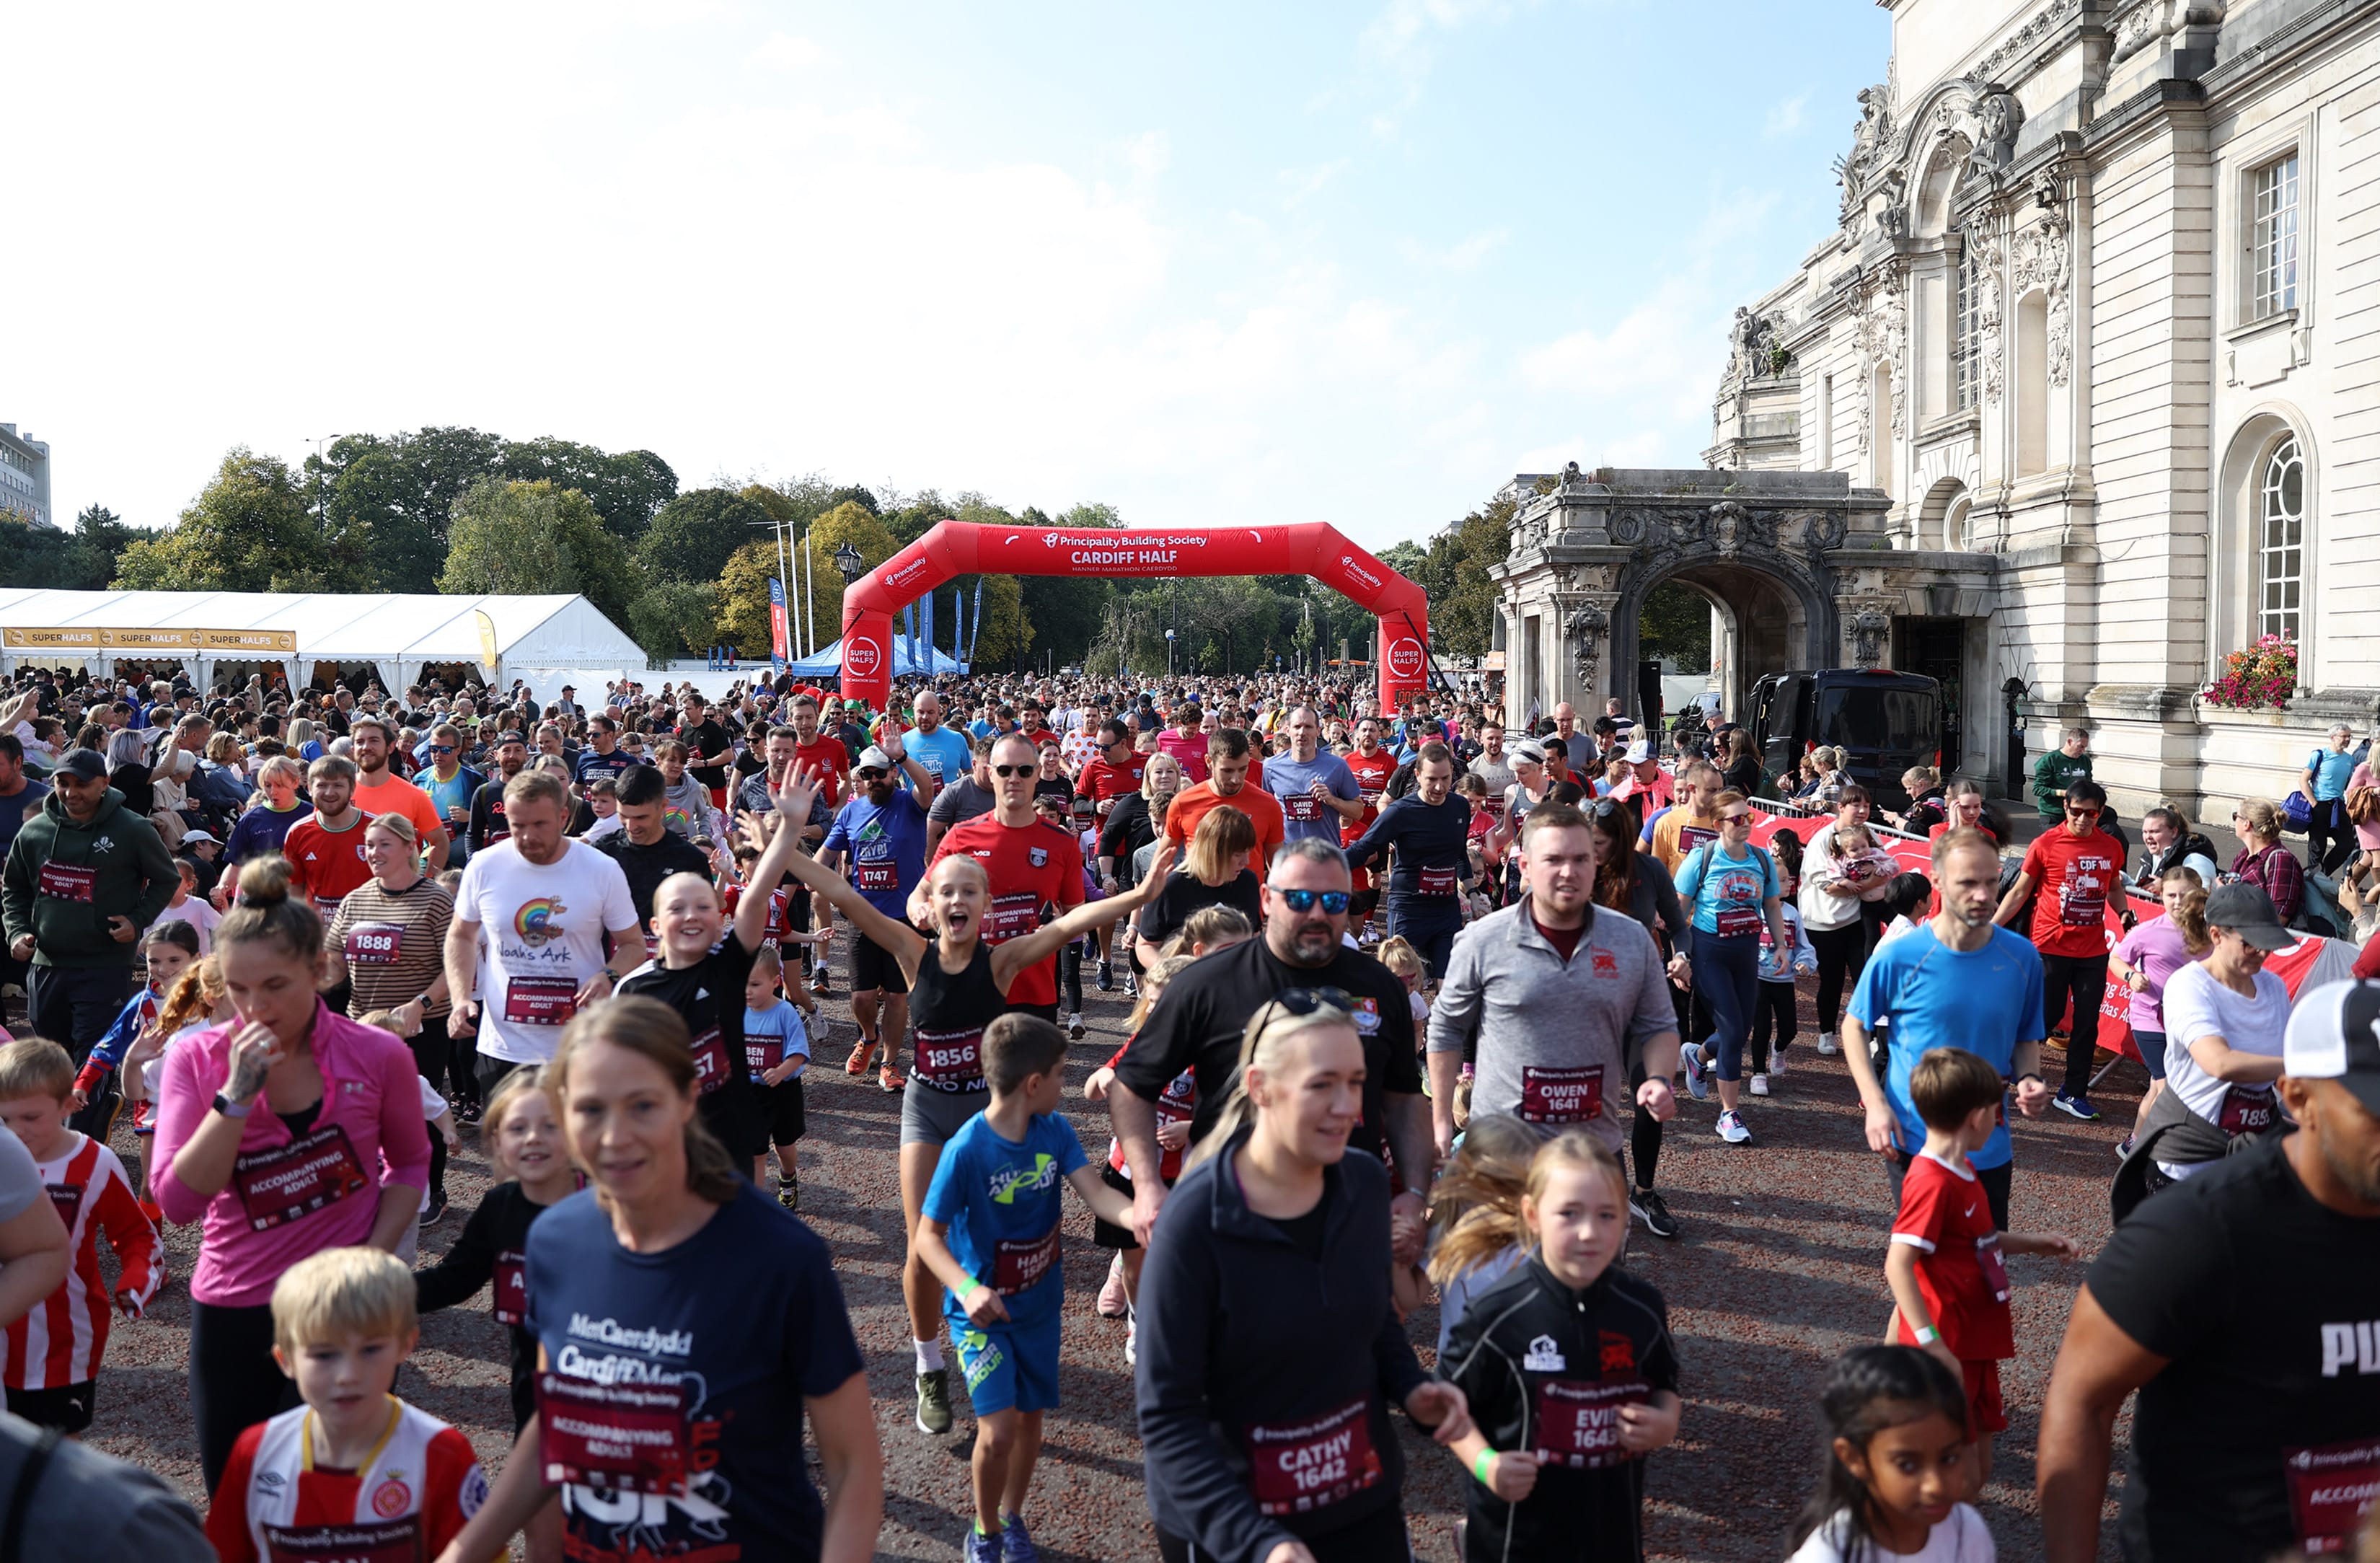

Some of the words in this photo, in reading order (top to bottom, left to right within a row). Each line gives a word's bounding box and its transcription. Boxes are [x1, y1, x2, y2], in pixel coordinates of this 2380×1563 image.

[1060, 536, 1119, 548] Principality
[1121, 537, 1165, 547] Building
[1168, 536, 1207, 547] Society
[1071, 551, 1134, 564] CARDIFF
[1140, 550, 1177, 563] HALF
[894, 557, 926, 580] Principality
[1349, 562, 1382, 587] Principality
[2080, 860, 2097, 870] CDF
[2098, 860, 2112, 870] 10K
[43, 873, 90, 884] ACCOMPANYING
[864, 871, 888, 881] 1747
[983, 908, 1034, 919] ACCOMPANYING
[356, 935, 392, 951] 1888
[541, 946, 572, 962] Ark
[746, 1047, 764, 1056] BEN
[927, 1045, 976, 1067] 1856
[746, 1057, 764, 1066] 1611
[1541, 1084, 1588, 1098] OWEN
[1548, 1098, 1579, 1110] 1641
[250, 1150, 344, 1194] ACCOMPANYING
[283, 1172, 319, 1195] ADULT
[552, 1415, 674, 1445] ACCOMPANYING
[586, 1439, 633, 1459] ADULT
[1279, 1429, 1352, 1472] CATHY
[1294, 1457, 1347, 1491] 1642
